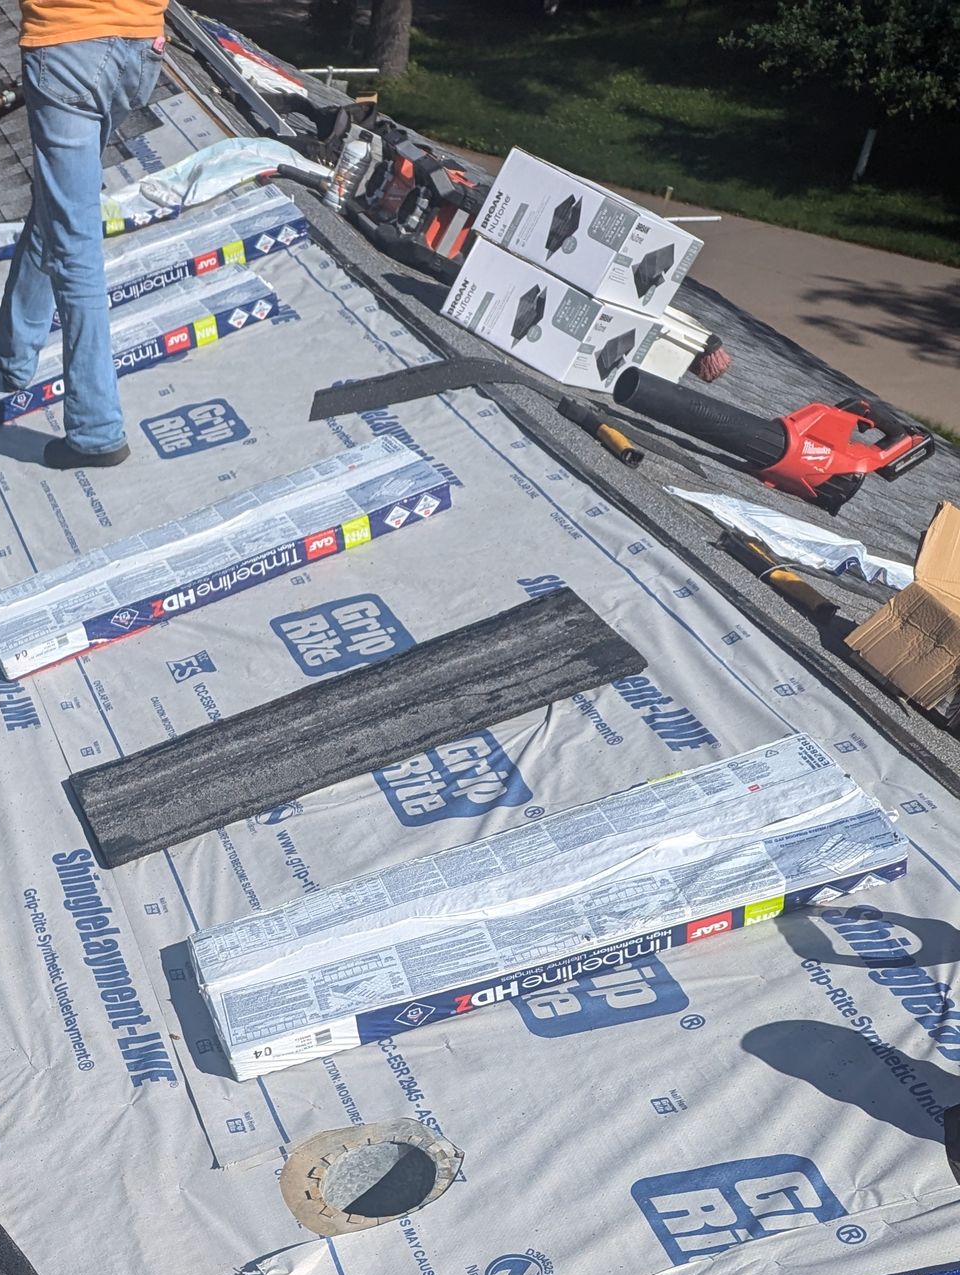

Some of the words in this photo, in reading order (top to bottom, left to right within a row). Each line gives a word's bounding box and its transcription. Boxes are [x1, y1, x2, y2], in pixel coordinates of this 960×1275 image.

[481, 191, 503, 229] BROAN
[112, 264, 190, 303] Timberline
[447, 277, 469, 315] BROAN
[148, 415, 193, 453] Rite
[188, 403, 236, 443] Grip
[309, 535, 334, 552] GAF
[197, 548, 301, 597] Timberline
[280, 615, 343, 667] Rite
[331, 601, 396, 655] Grip
[168, 656, 202, 680] ES
[381, 752, 448, 816] Rite
[435, 734, 510, 805] Grip
[241, 881, 263, 911] SLIPPERY
[689, 918, 729, 940] GAF
[23, 887, 47, 933] Grip-Rite
[37, 933, 63, 984] Synthetic
[54, 982, 95, 1072] Underlayment®
[522, 935, 672, 989] Timberline
[800, 957, 858, 1018] Grip-Rite
[851, 1015, 917, 1085] Synthetic
[398, 1077, 424, 1103] 2945
[402, 1228, 422, 1249] MAY
